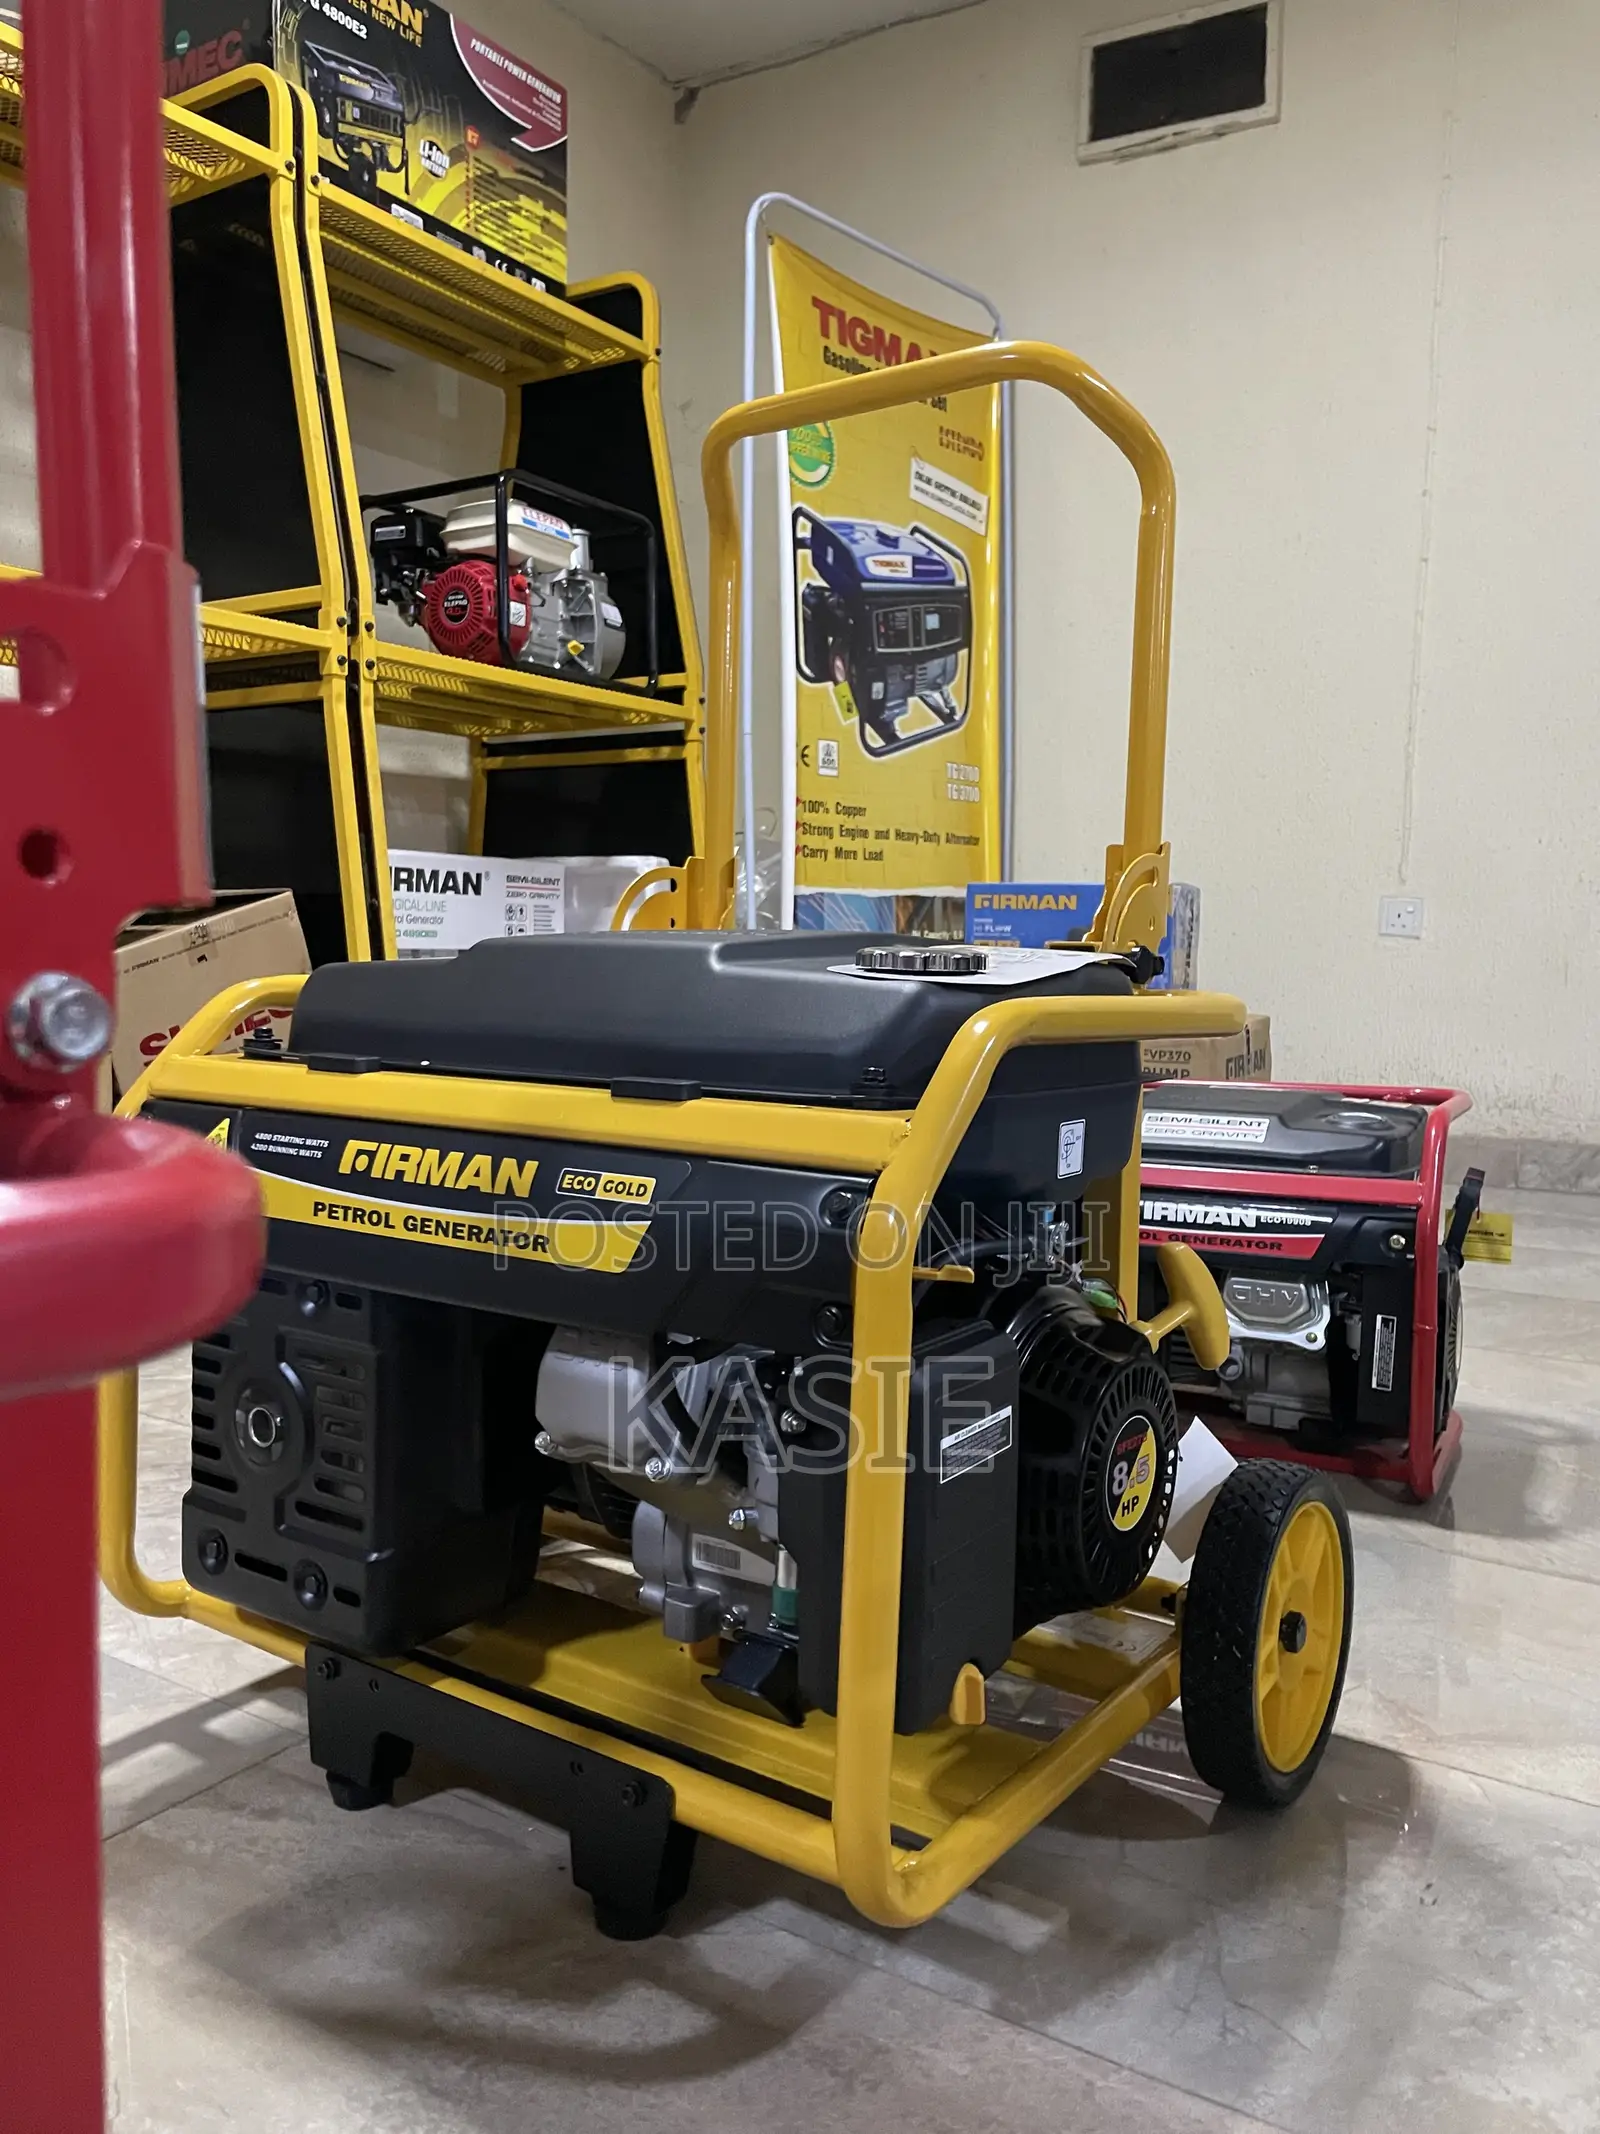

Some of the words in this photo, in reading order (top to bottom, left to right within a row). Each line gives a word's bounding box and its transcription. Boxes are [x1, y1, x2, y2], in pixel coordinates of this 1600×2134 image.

[322, 2, 368, 40] 4800E2
[371, 7, 397, 31] NEW
[400, 24, 423, 48] LIFE
[801, 800, 830, 815] 100%
[835, 801, 867, 818] Copper
[801, 821, 834, 840] Strong
[839, 824, 870, 841] Engine
[874, 827, 890, 841] and
[894, 828, 941, 846] Heavy-Duty
[945, 831, 981, 847] Alternator
[801, 844, 829, 863] Carry
[834, 846, 858, 861] More
[863, 847, 884, 862] Load
[973, 894, 1078, 911] FIRMAN
[405, 913, 445, 925] Generator
[1147, 1115, 1267, 1128] SEMI-SILENT
[254, 1132, 273, 1142] 4800
[271, 1134, 306, 1146] STARTING
[305, 1138, 330, 1149] WATTS
[1145, 1127, 1187, 1136] ZERO
[1191, 1129, 1263, 1140] GRAVITY
[250, 1143, 269, 1152] 4200
[267, 1144, 299, 1156] RUNNING
[298, 1149, 323, 1159] WATTS
[338, 1139, 540, 1198] FIRMAN
[561, 1173, 597, 1191] ECO
[602, 1178, 648, 1198] GOLD
[312, 1201, 396, 1230] PETROL
[402, 1215, 550, 1254] GENERATOR
[1168, 1233, 1283, 1251] GENERATOR
[1111, 1453, 1151, 1497] 8.5
[1121, 1495, 1140, 1518] HP
